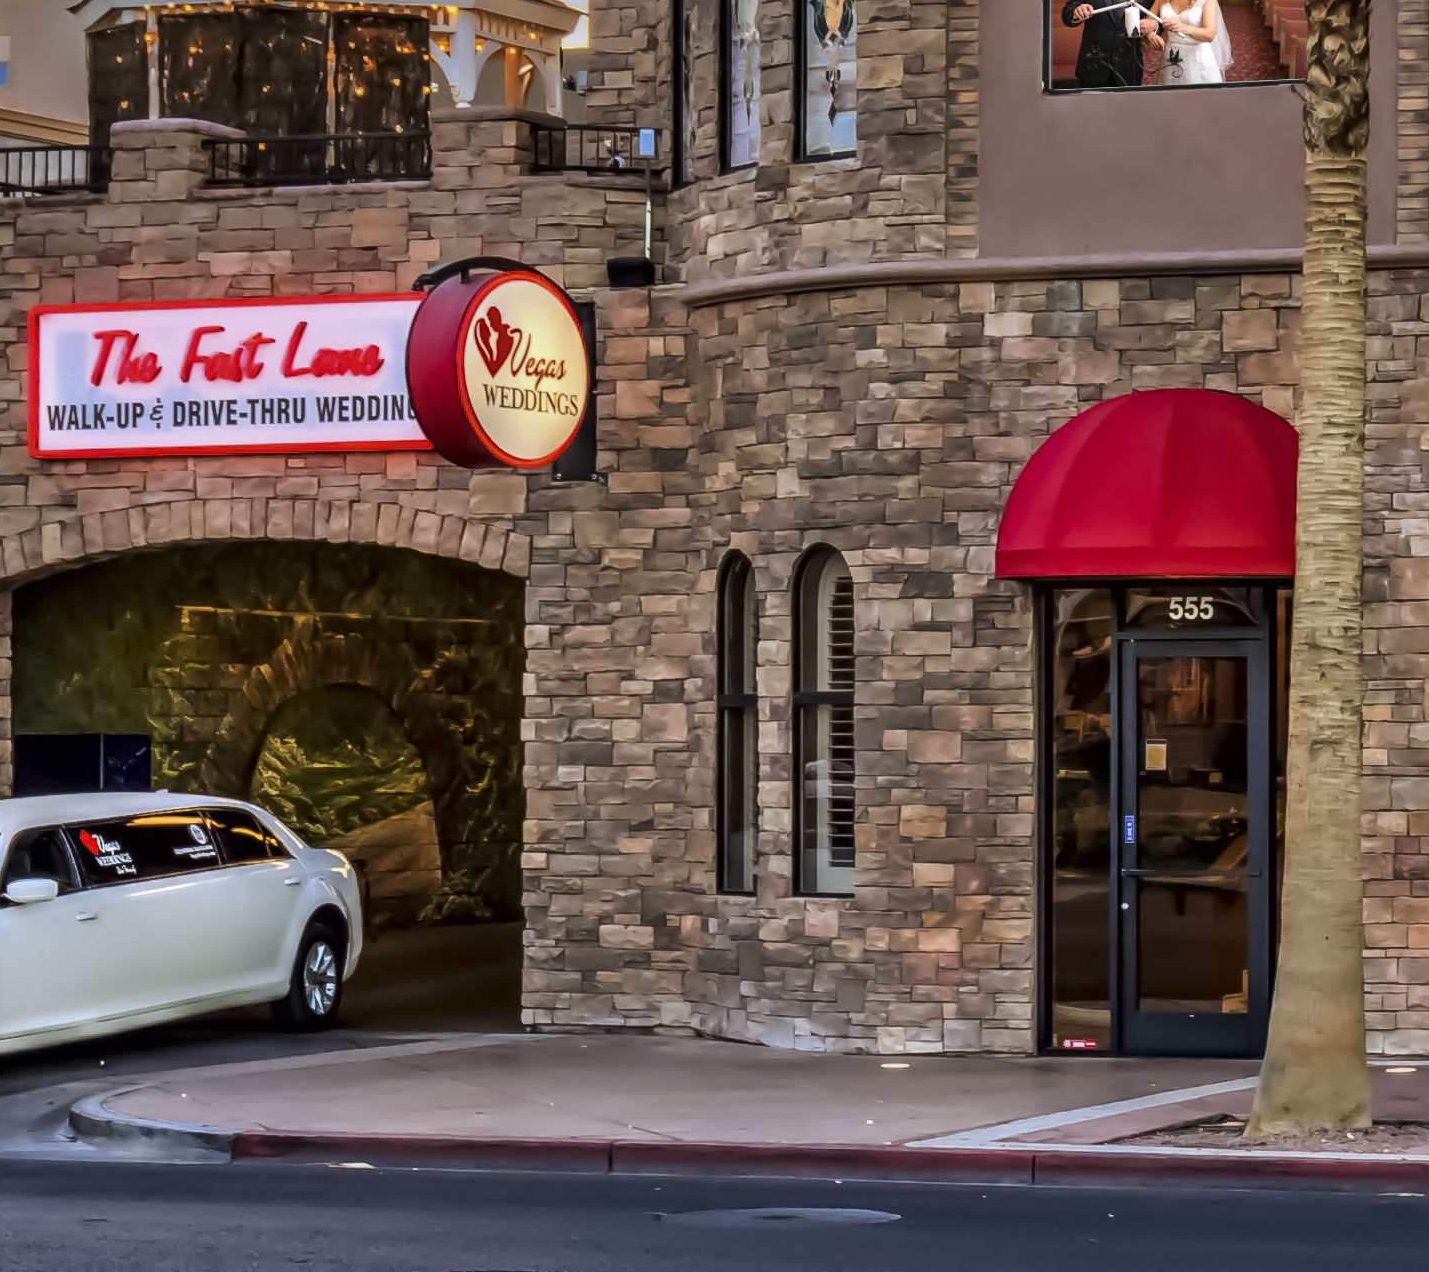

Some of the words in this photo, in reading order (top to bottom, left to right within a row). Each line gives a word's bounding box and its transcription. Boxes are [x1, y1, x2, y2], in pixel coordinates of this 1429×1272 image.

[90, 329, 163, 386] The
[179, 325, 276, 383] Fast
[280, 320, 385, 378] Lane
[509, 327, 567, 390] Vegas
[47, 401, 144, 431] WALK-UP
[172, 397, 307, 428] DRIVE-THRU
[482, 383, 579, 417] WEDDINGS
[1168, 596, 1214, 620] 555
